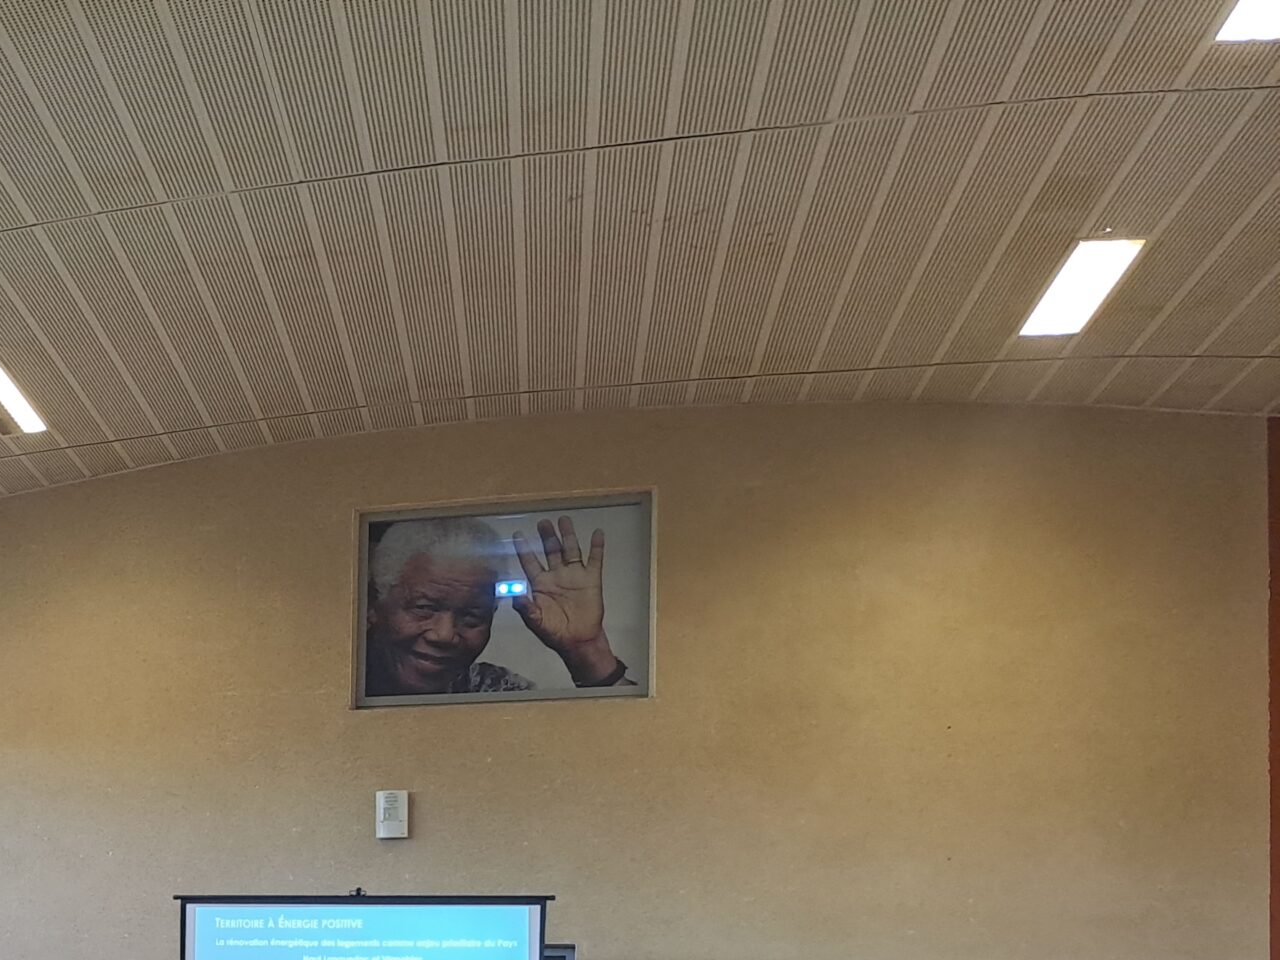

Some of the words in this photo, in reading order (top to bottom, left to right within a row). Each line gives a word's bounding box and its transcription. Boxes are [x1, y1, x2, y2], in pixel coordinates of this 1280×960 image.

[215, 917, 264, 929] TERRITOIRE
[267, 915, 275, 929] À
[278, 914, 319, 929] ÉNERGIE
[322, 918, 364, 929] POSITIVE
[215, 938, 226, 947] La
[226, 937, 269, 947] rénovation
[270, 938, 319, 949] énergétique
[321, 938, 335, 947] des
[497, 939, 518, 949] Pays
